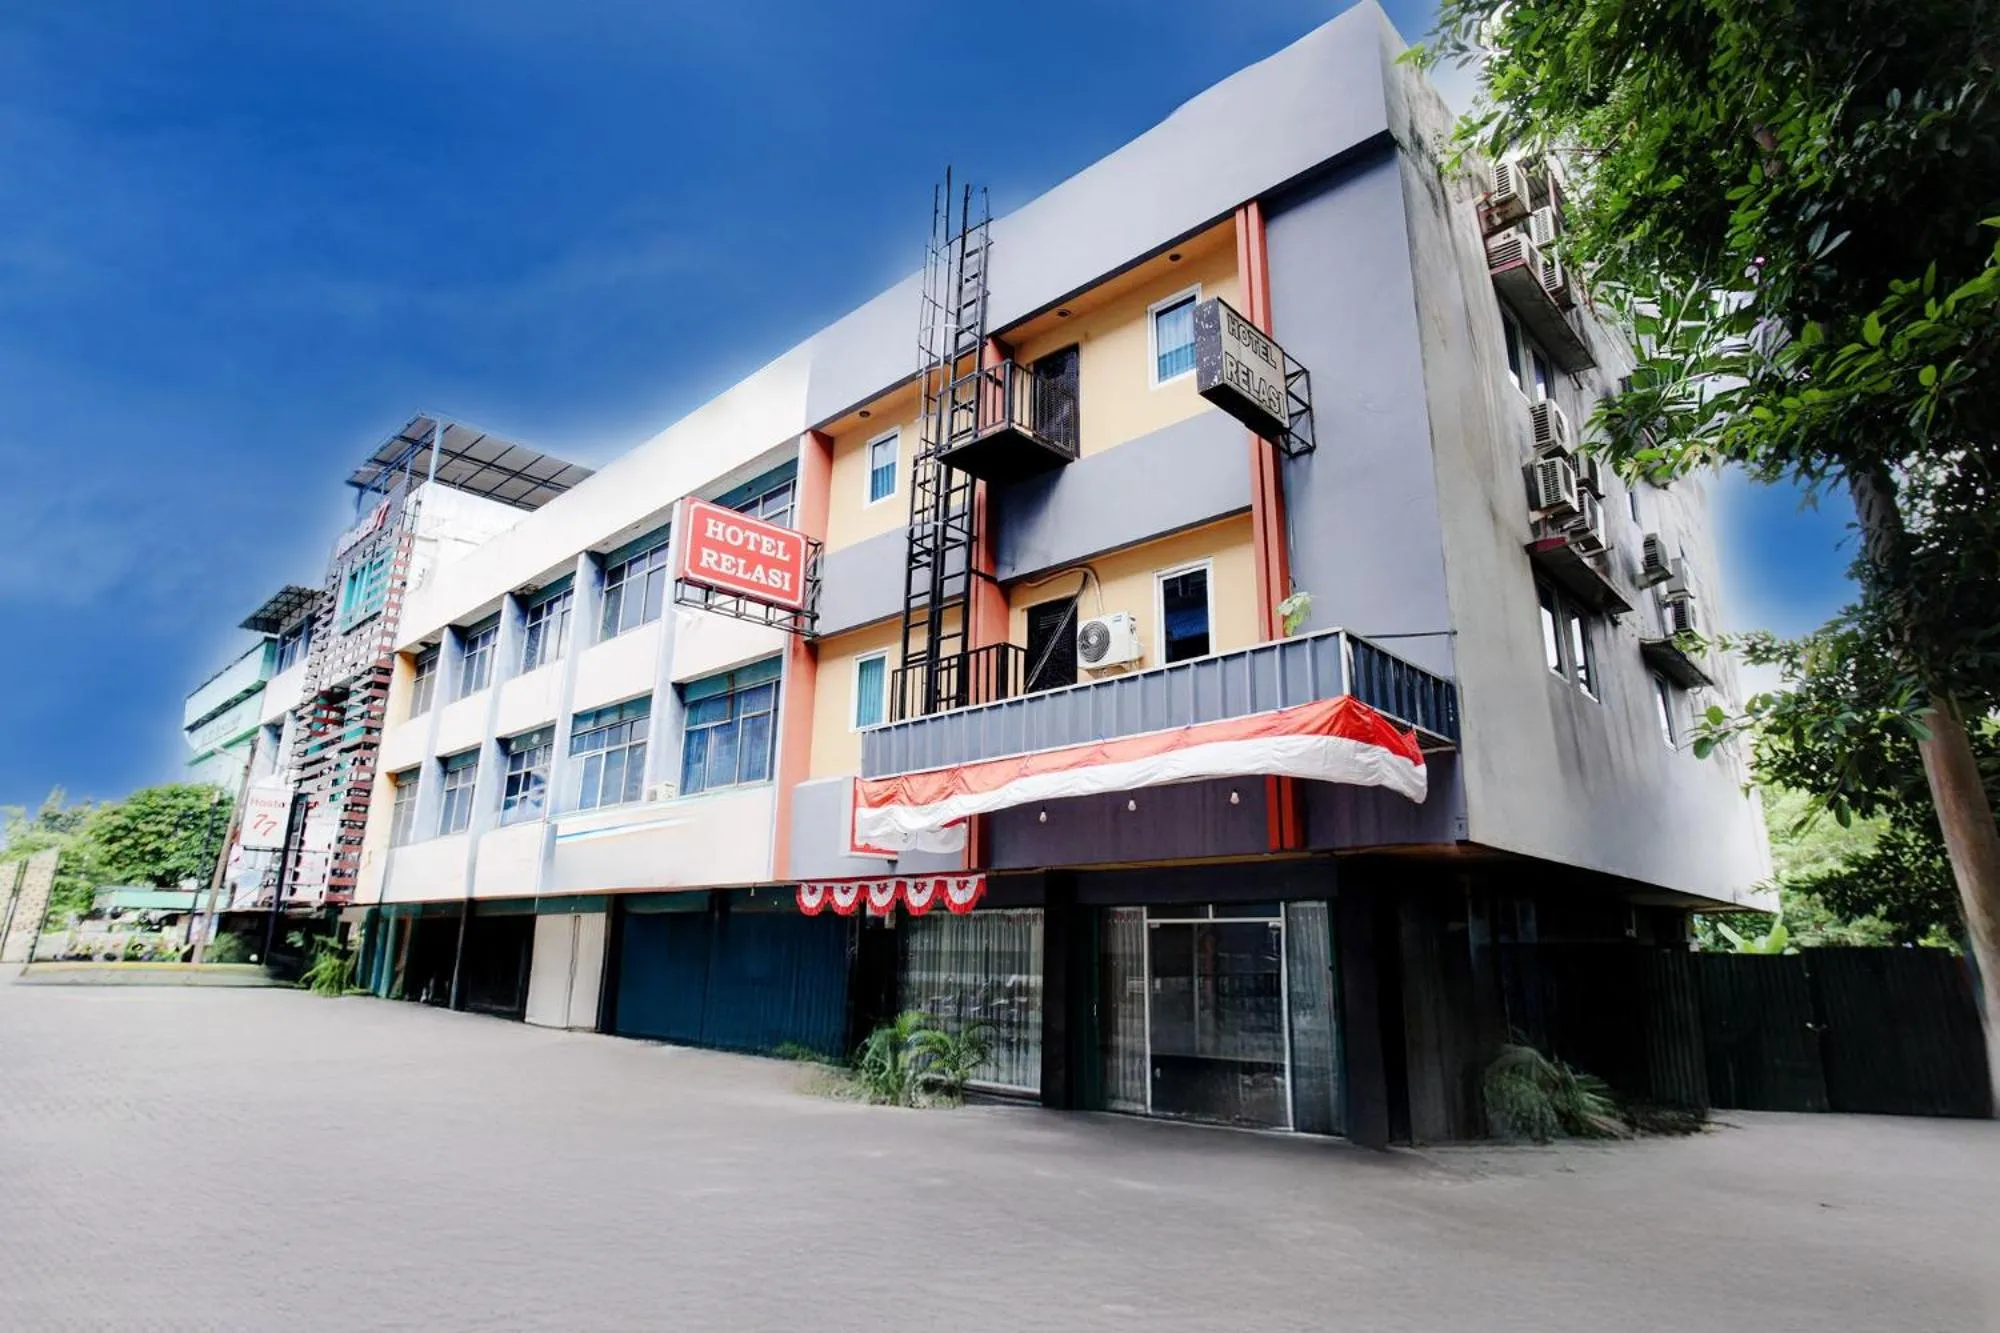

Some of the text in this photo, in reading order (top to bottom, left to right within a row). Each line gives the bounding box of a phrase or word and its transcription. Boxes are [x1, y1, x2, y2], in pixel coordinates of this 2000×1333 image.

[1227, 311, 1277, 369] HOTEL
[1224, 351, 1286, 420] RELASI
[705, 517, 790, 562] HOTEL
[699, 546, 793, 592] RELASI
[253, 813, 278, 836] 77
